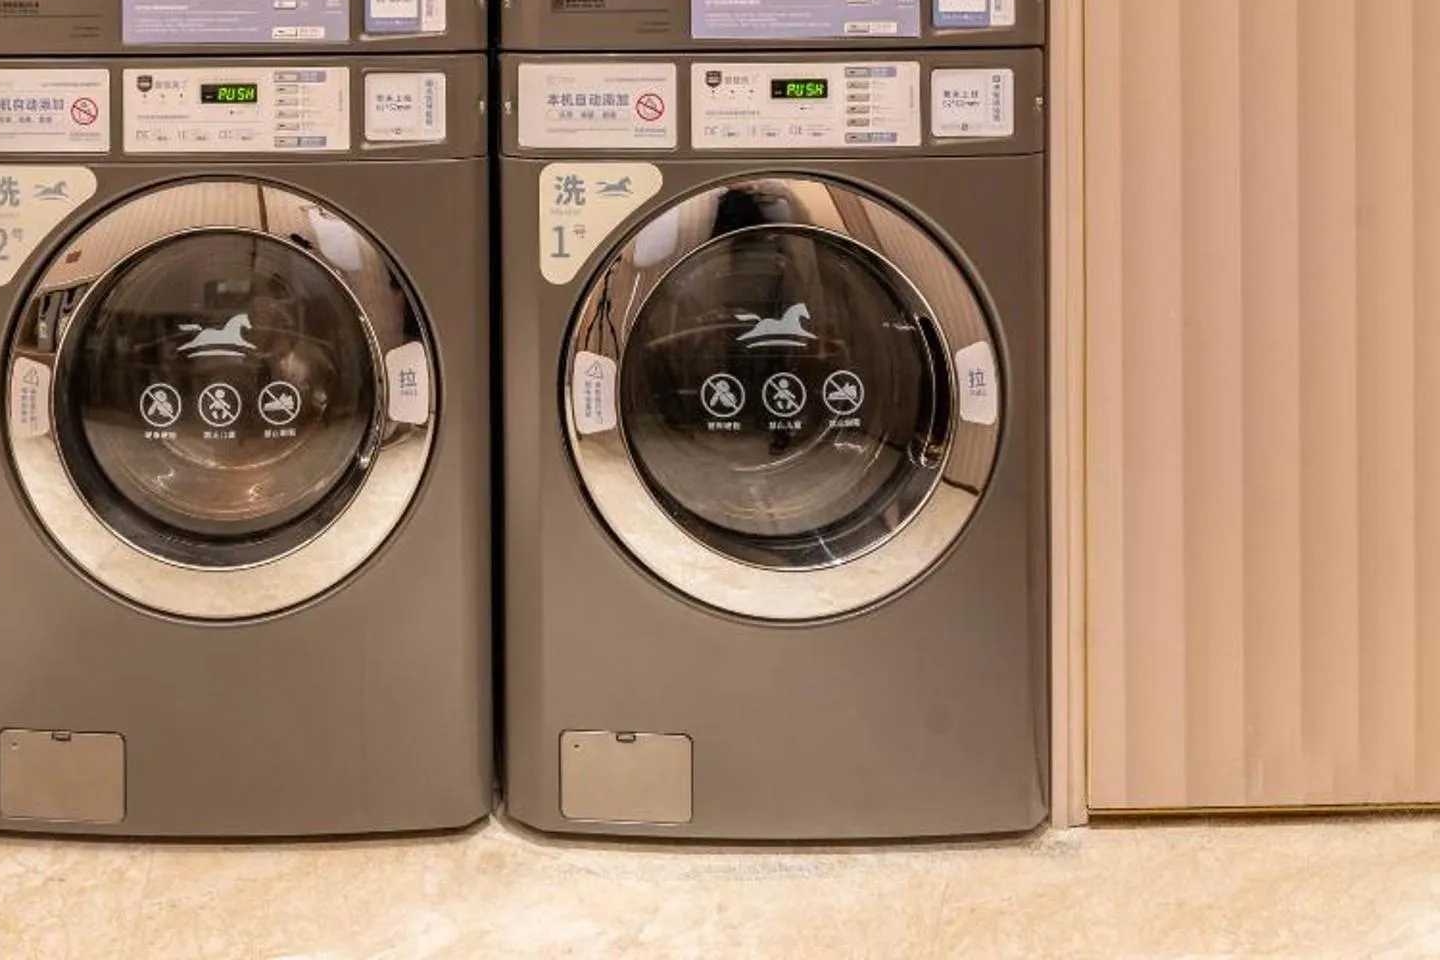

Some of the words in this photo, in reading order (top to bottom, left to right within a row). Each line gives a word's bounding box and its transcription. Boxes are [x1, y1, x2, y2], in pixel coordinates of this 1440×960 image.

[217, 88, 255, 101] PUSH
[786, 83, 824, 96] PUSH
[554, 175, 586, 207] 洗
[400, 368, 417, 388] 拉
[969, 366, 987, 388] 拉
